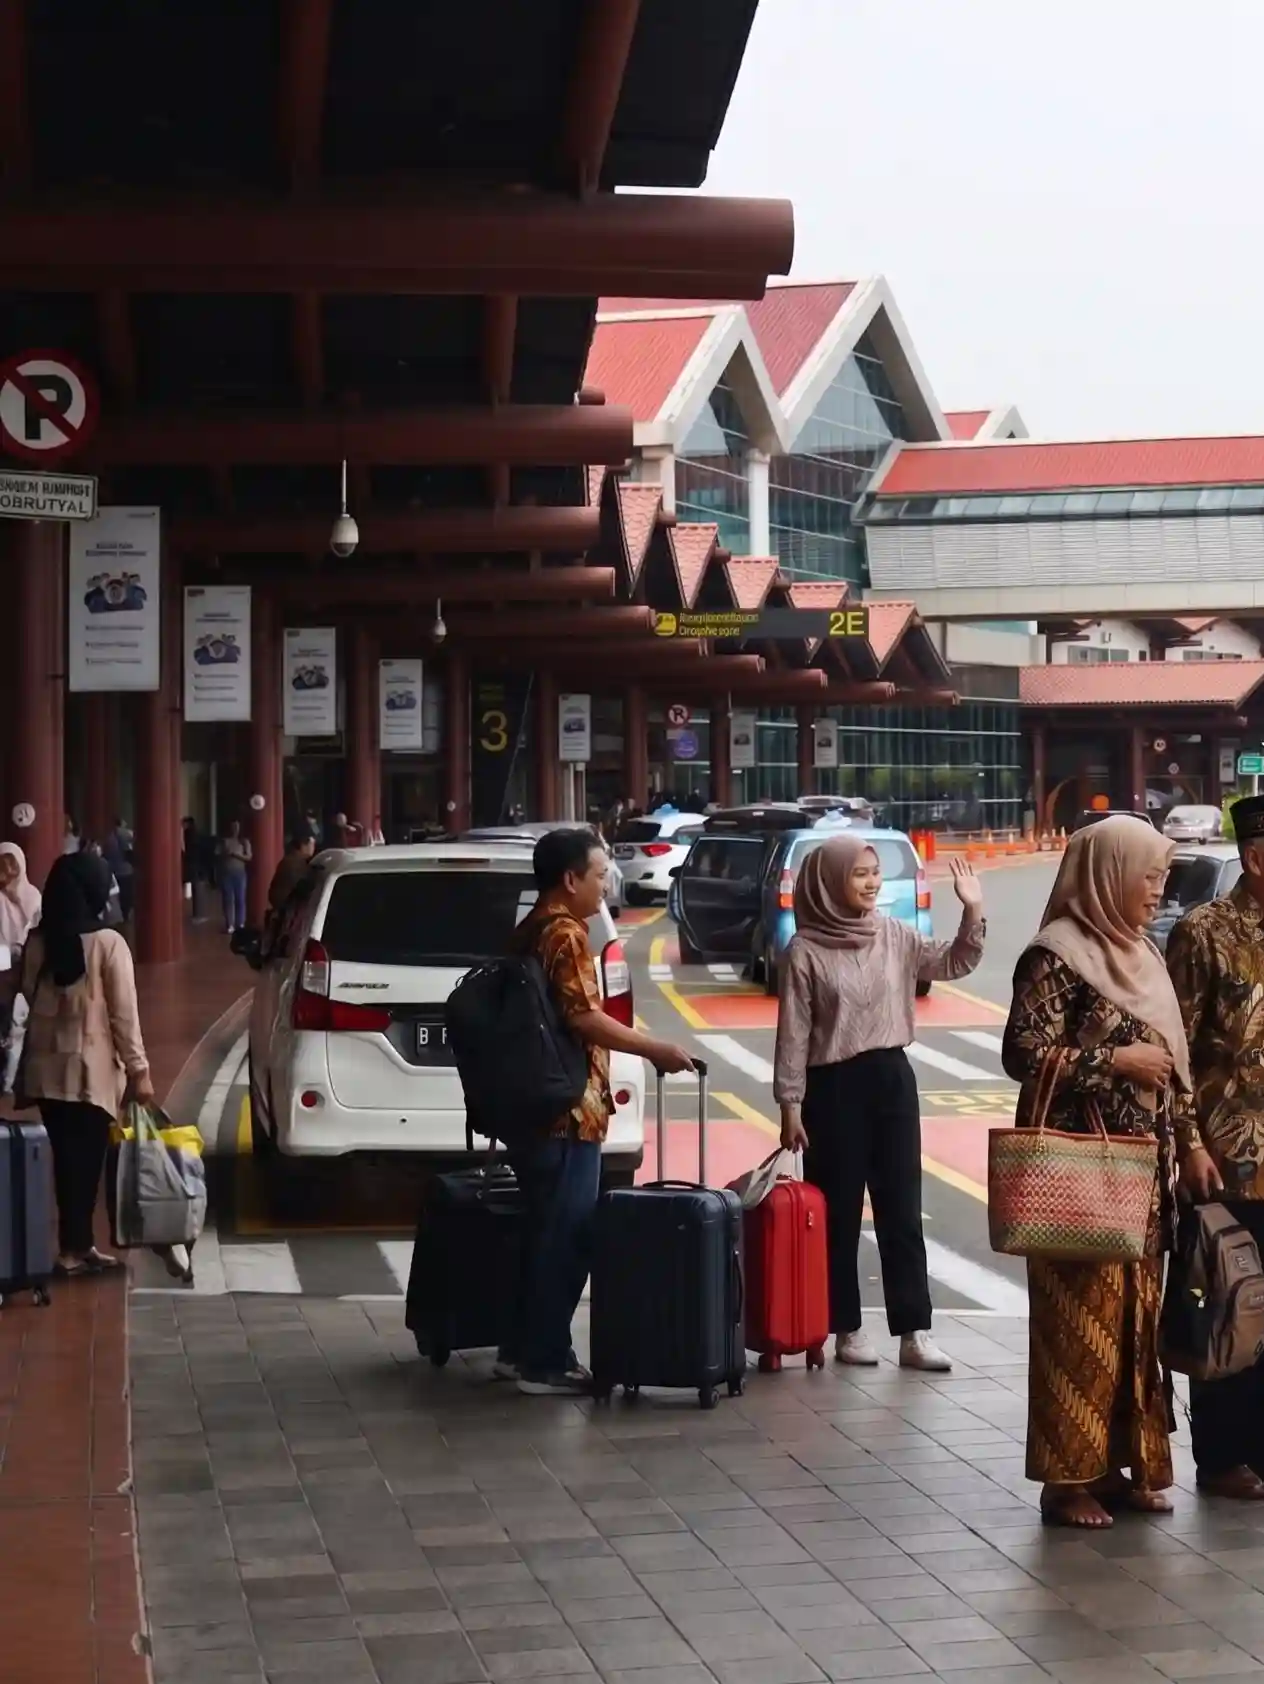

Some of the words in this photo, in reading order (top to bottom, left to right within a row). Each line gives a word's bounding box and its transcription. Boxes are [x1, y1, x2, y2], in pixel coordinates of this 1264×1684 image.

[829, 611, 865, 635] 2E
[479, 708, 508, 752] 3
[419, 1026, 429, 1046] B
